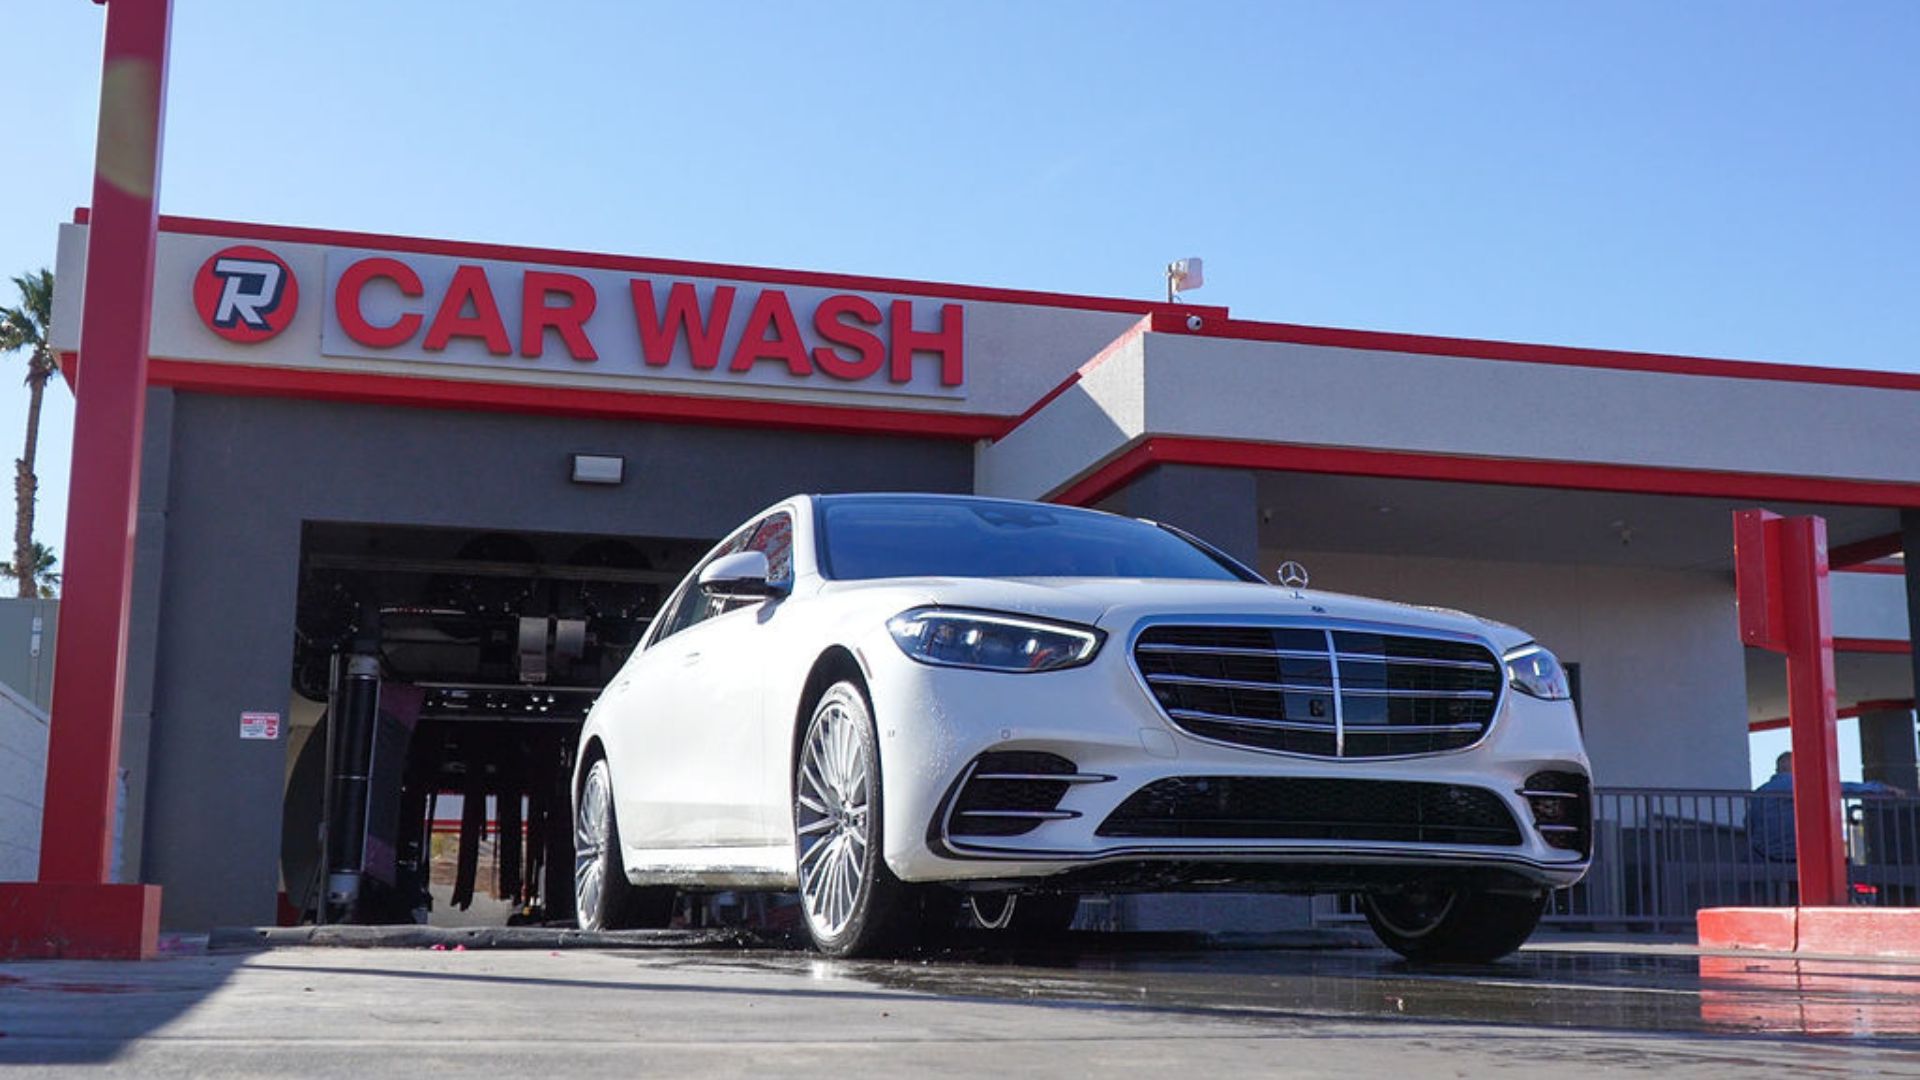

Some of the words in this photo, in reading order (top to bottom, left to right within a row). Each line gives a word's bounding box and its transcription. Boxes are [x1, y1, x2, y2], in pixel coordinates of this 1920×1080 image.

[212, 258, 289, 331] R
[336, 258, 598, 360] CAR
[630, 279, 963, 386] WASH
